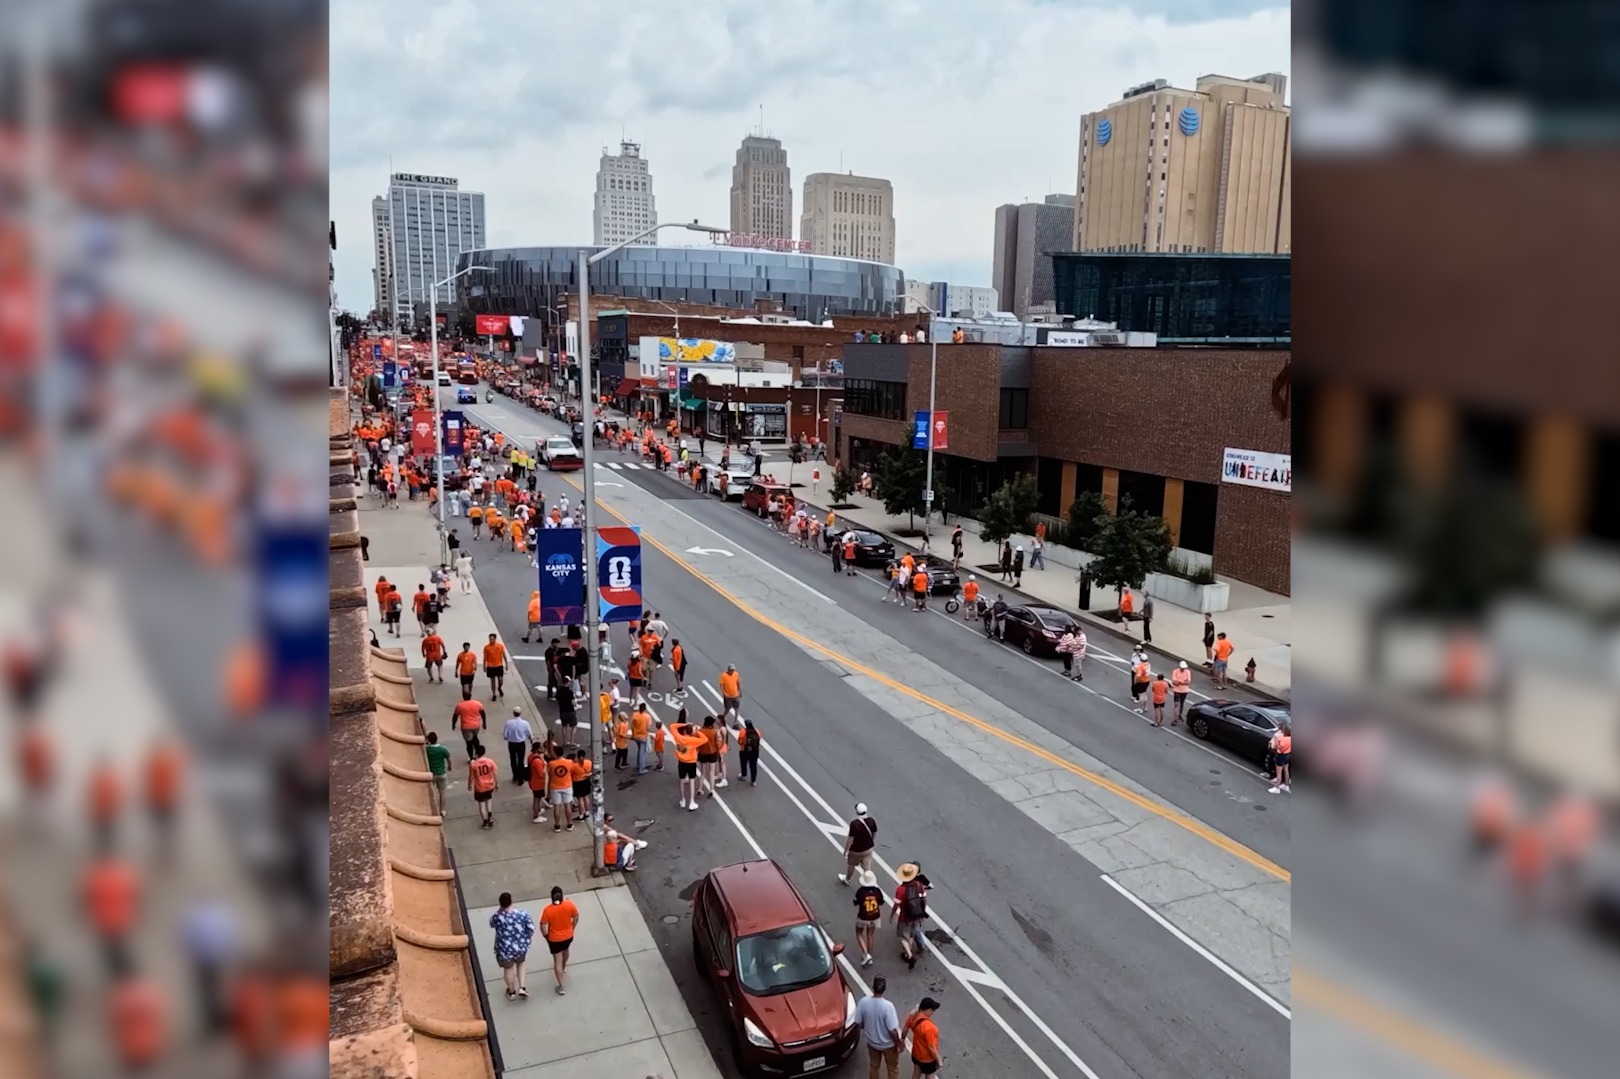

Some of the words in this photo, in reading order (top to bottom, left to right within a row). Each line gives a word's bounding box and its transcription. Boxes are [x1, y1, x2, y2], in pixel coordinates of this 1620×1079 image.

[396, 173, 417, 182] THE
[420, 175, 458, 185] GRAND
[767, 238, 812, 250] CENTER
[478, 764, 489, 776] 10
